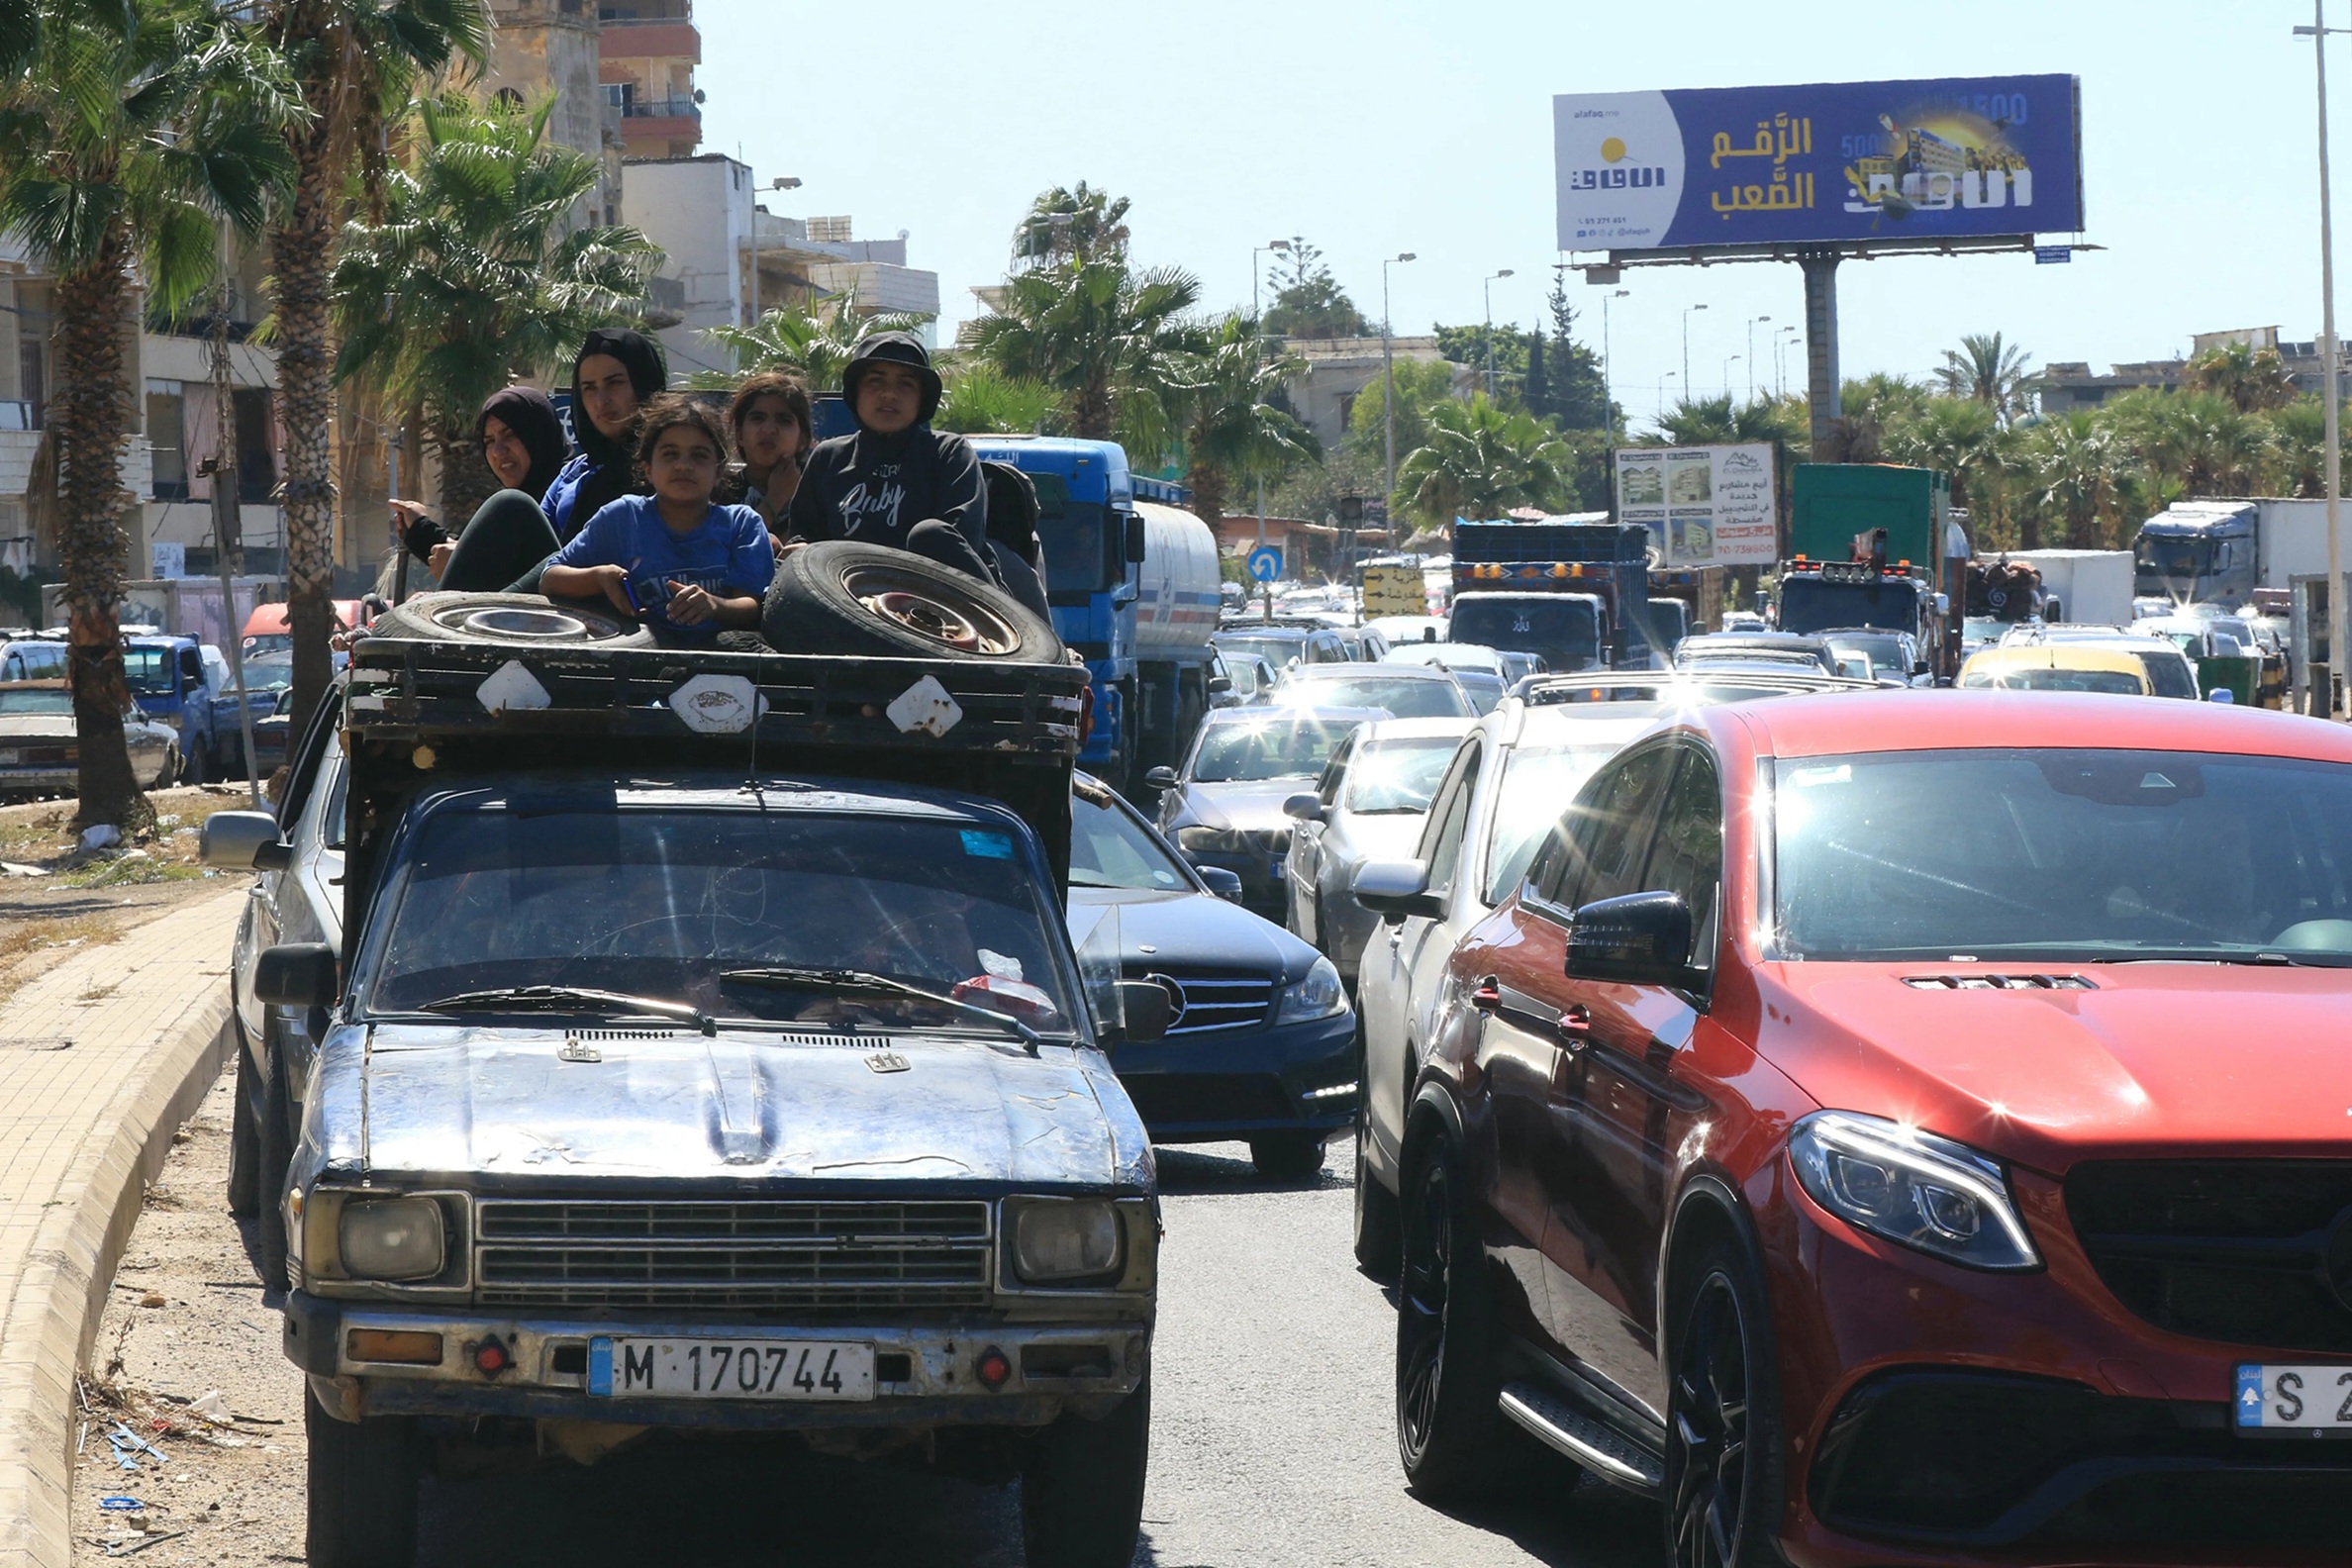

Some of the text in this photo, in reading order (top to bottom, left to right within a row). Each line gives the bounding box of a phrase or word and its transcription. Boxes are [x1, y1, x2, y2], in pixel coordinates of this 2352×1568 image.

[1574, 110, 1620, 119] alafaq.me
[625, 1345, 842, 1395] M 170744
[2239, 1368, 2262, 1382] لبنان
[2276, 1372, 2304, 1422] S
